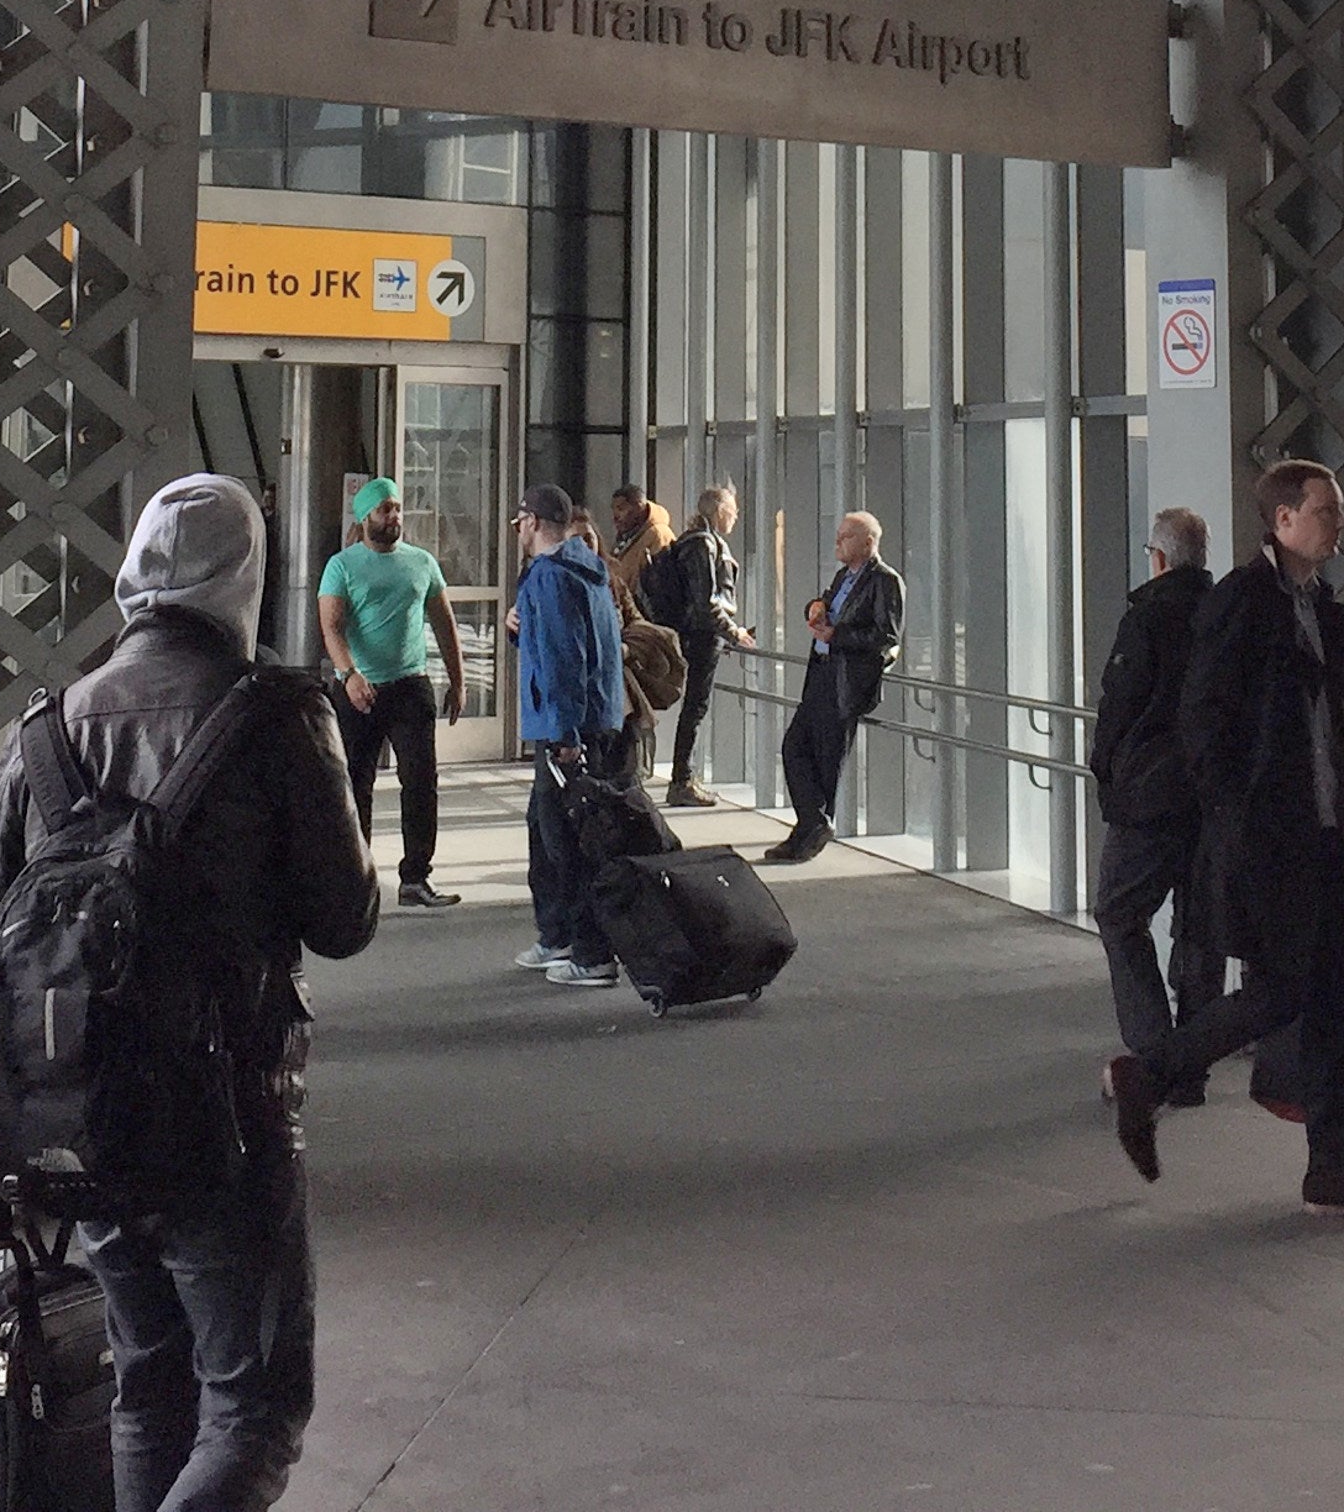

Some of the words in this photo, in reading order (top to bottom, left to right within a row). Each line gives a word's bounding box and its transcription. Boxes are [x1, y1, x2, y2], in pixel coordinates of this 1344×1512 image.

[702, 1, 754, 53] to
[765, 8, 860, 64] JFK
[871, 17, 1031, 88] Airport
[266, 268, 299, 296] to
[310, 269, 362, 299] JFK
[1162, 296, 1173, 305] No
[1175, 294, 1211, 305] Smoking
